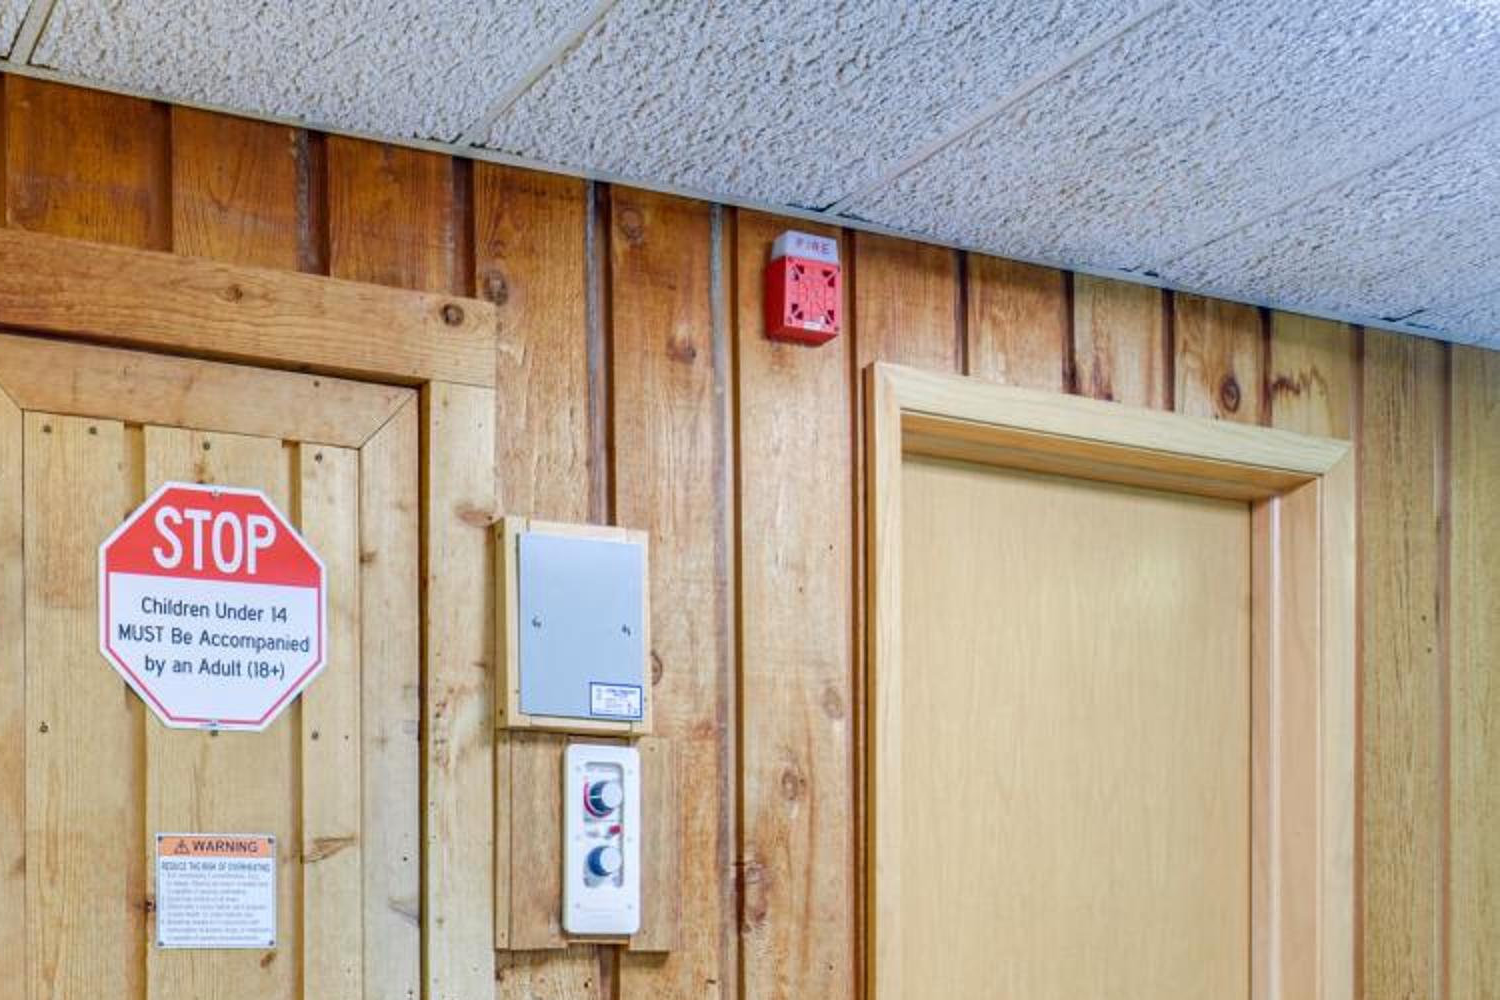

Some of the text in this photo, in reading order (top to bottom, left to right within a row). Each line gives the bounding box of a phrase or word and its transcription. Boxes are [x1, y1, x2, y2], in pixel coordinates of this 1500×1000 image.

[152, 505, 277, 575] STOP
[141, 596, 288, 623] Children Under 14
[118, 623, 309, 654] MUST Be Accompanied
[144, 655, 285, 680] by an Adult (18+)
[192, 839, 259, 854] WARNING
